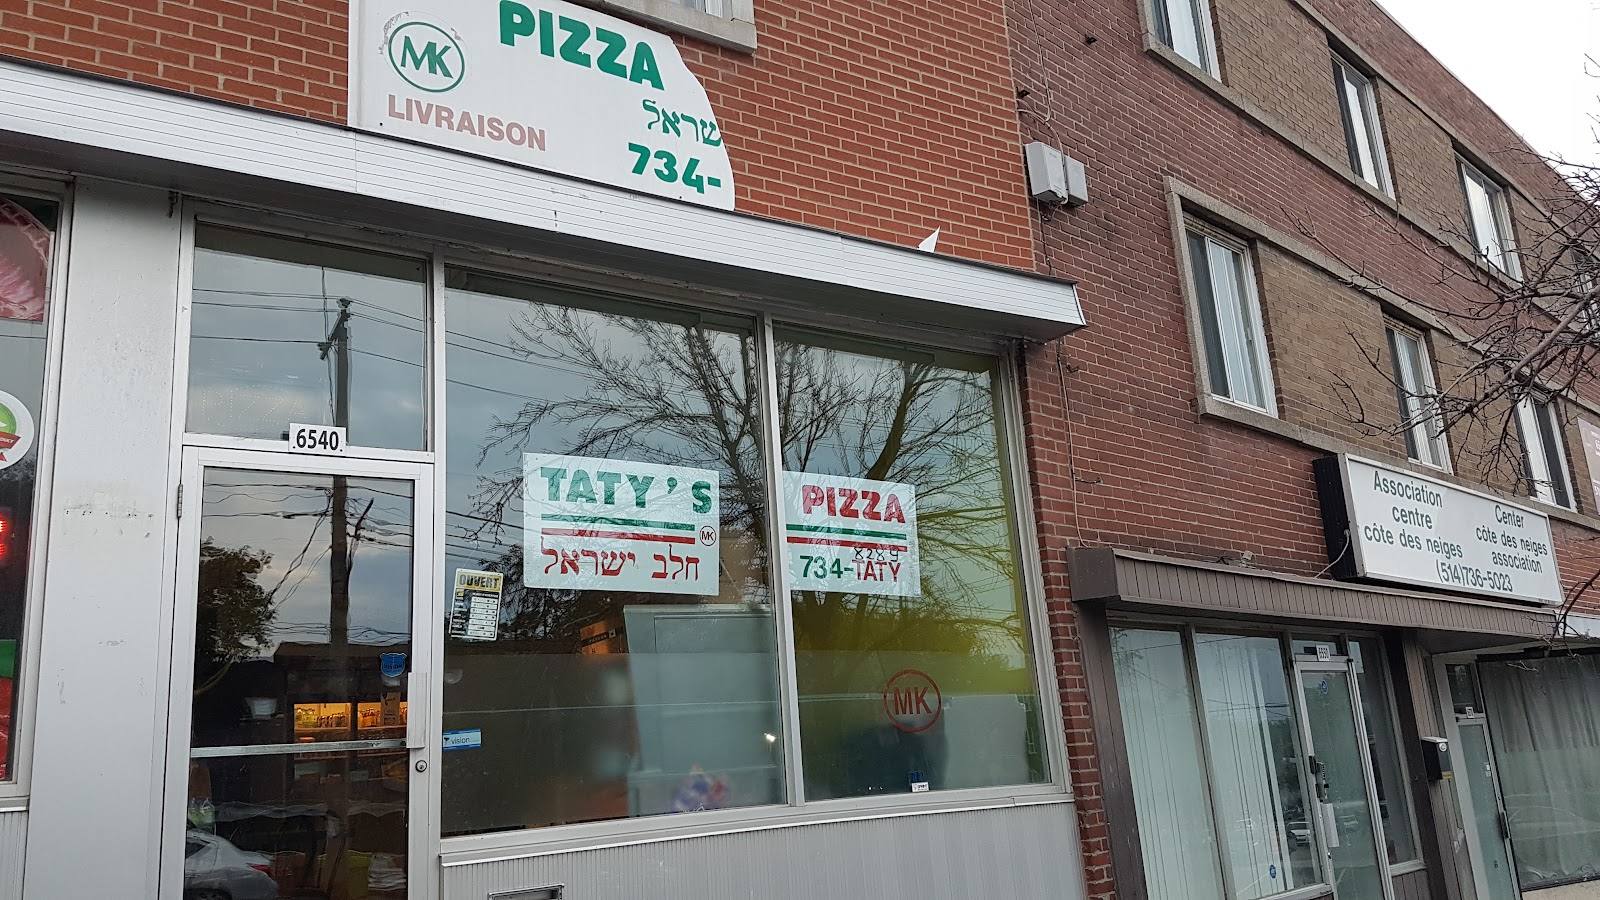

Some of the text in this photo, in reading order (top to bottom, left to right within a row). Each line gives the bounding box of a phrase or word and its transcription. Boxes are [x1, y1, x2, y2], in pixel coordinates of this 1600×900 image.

[400, 36, 454, 79] MK
[499, 0, 664, 90] PIZZA
[387, 94, 547, 152] LIVRAISON
[628, 142, 722, 194] 734-
[296, 428, 339, 451] 6540
[540, 466, 712, 514] TATY'S
[803, 485, 906, 524] PIZZA
[1373, 470, 1443, 508] Association
[1392, 506, 1433, 530] centre
[1494, 504, 1525, 528] Center
[540, 535, 700, 582] חלב ישראל
[853, 547, 899, 562] 8289
[1364, 522, 1463, 560] côte des neiges
[1475, 524, 1548, 557] côte des neiges
[1435, 558, 1513, 593] (514)736-5023
[1491, 551, 1543, 574] association
[459, 574, 500, 589] OUVERT
[893, 686, 933, 715] MK
